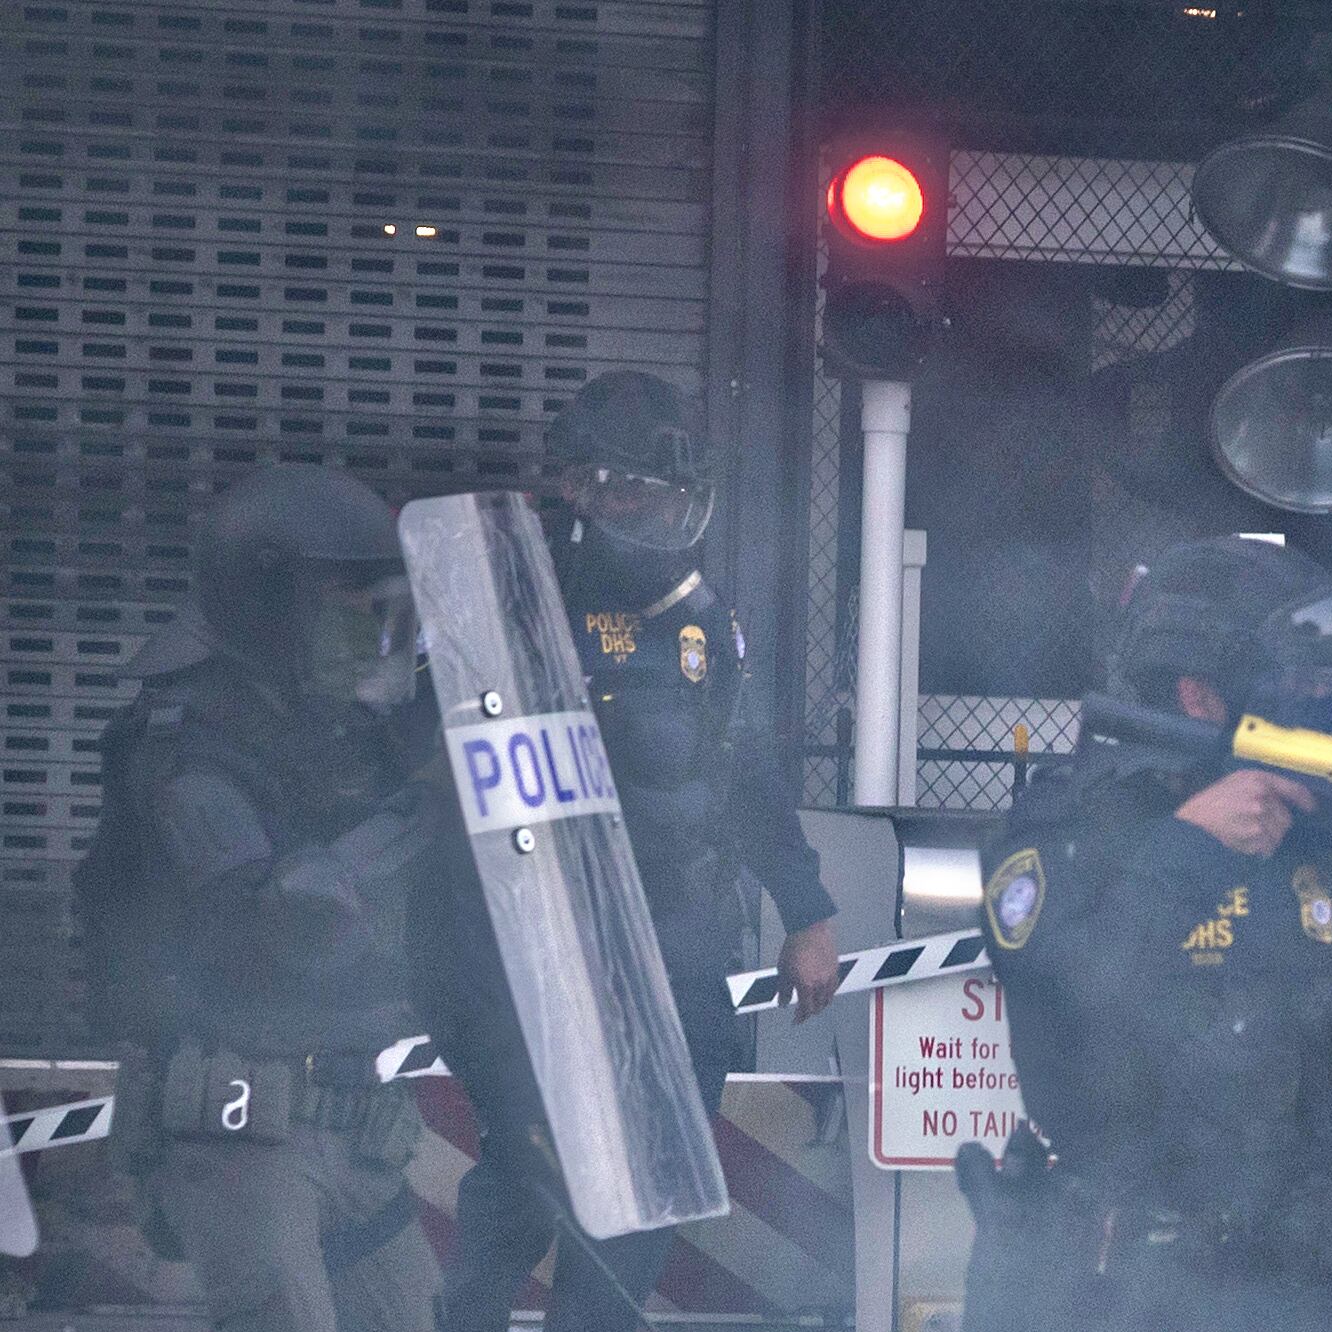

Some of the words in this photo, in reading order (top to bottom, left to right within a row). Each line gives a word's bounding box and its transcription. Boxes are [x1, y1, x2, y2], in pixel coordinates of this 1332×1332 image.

[601, 632, 636, 653] DHS
[919, 1036, 963, 1059] Wait
[971, 1037, 1000, 1060] for
[895, 1066, 944, 1095] light
[952, 1067, 1018, 1090] before
[923, 1110, 958, 1138] NO
